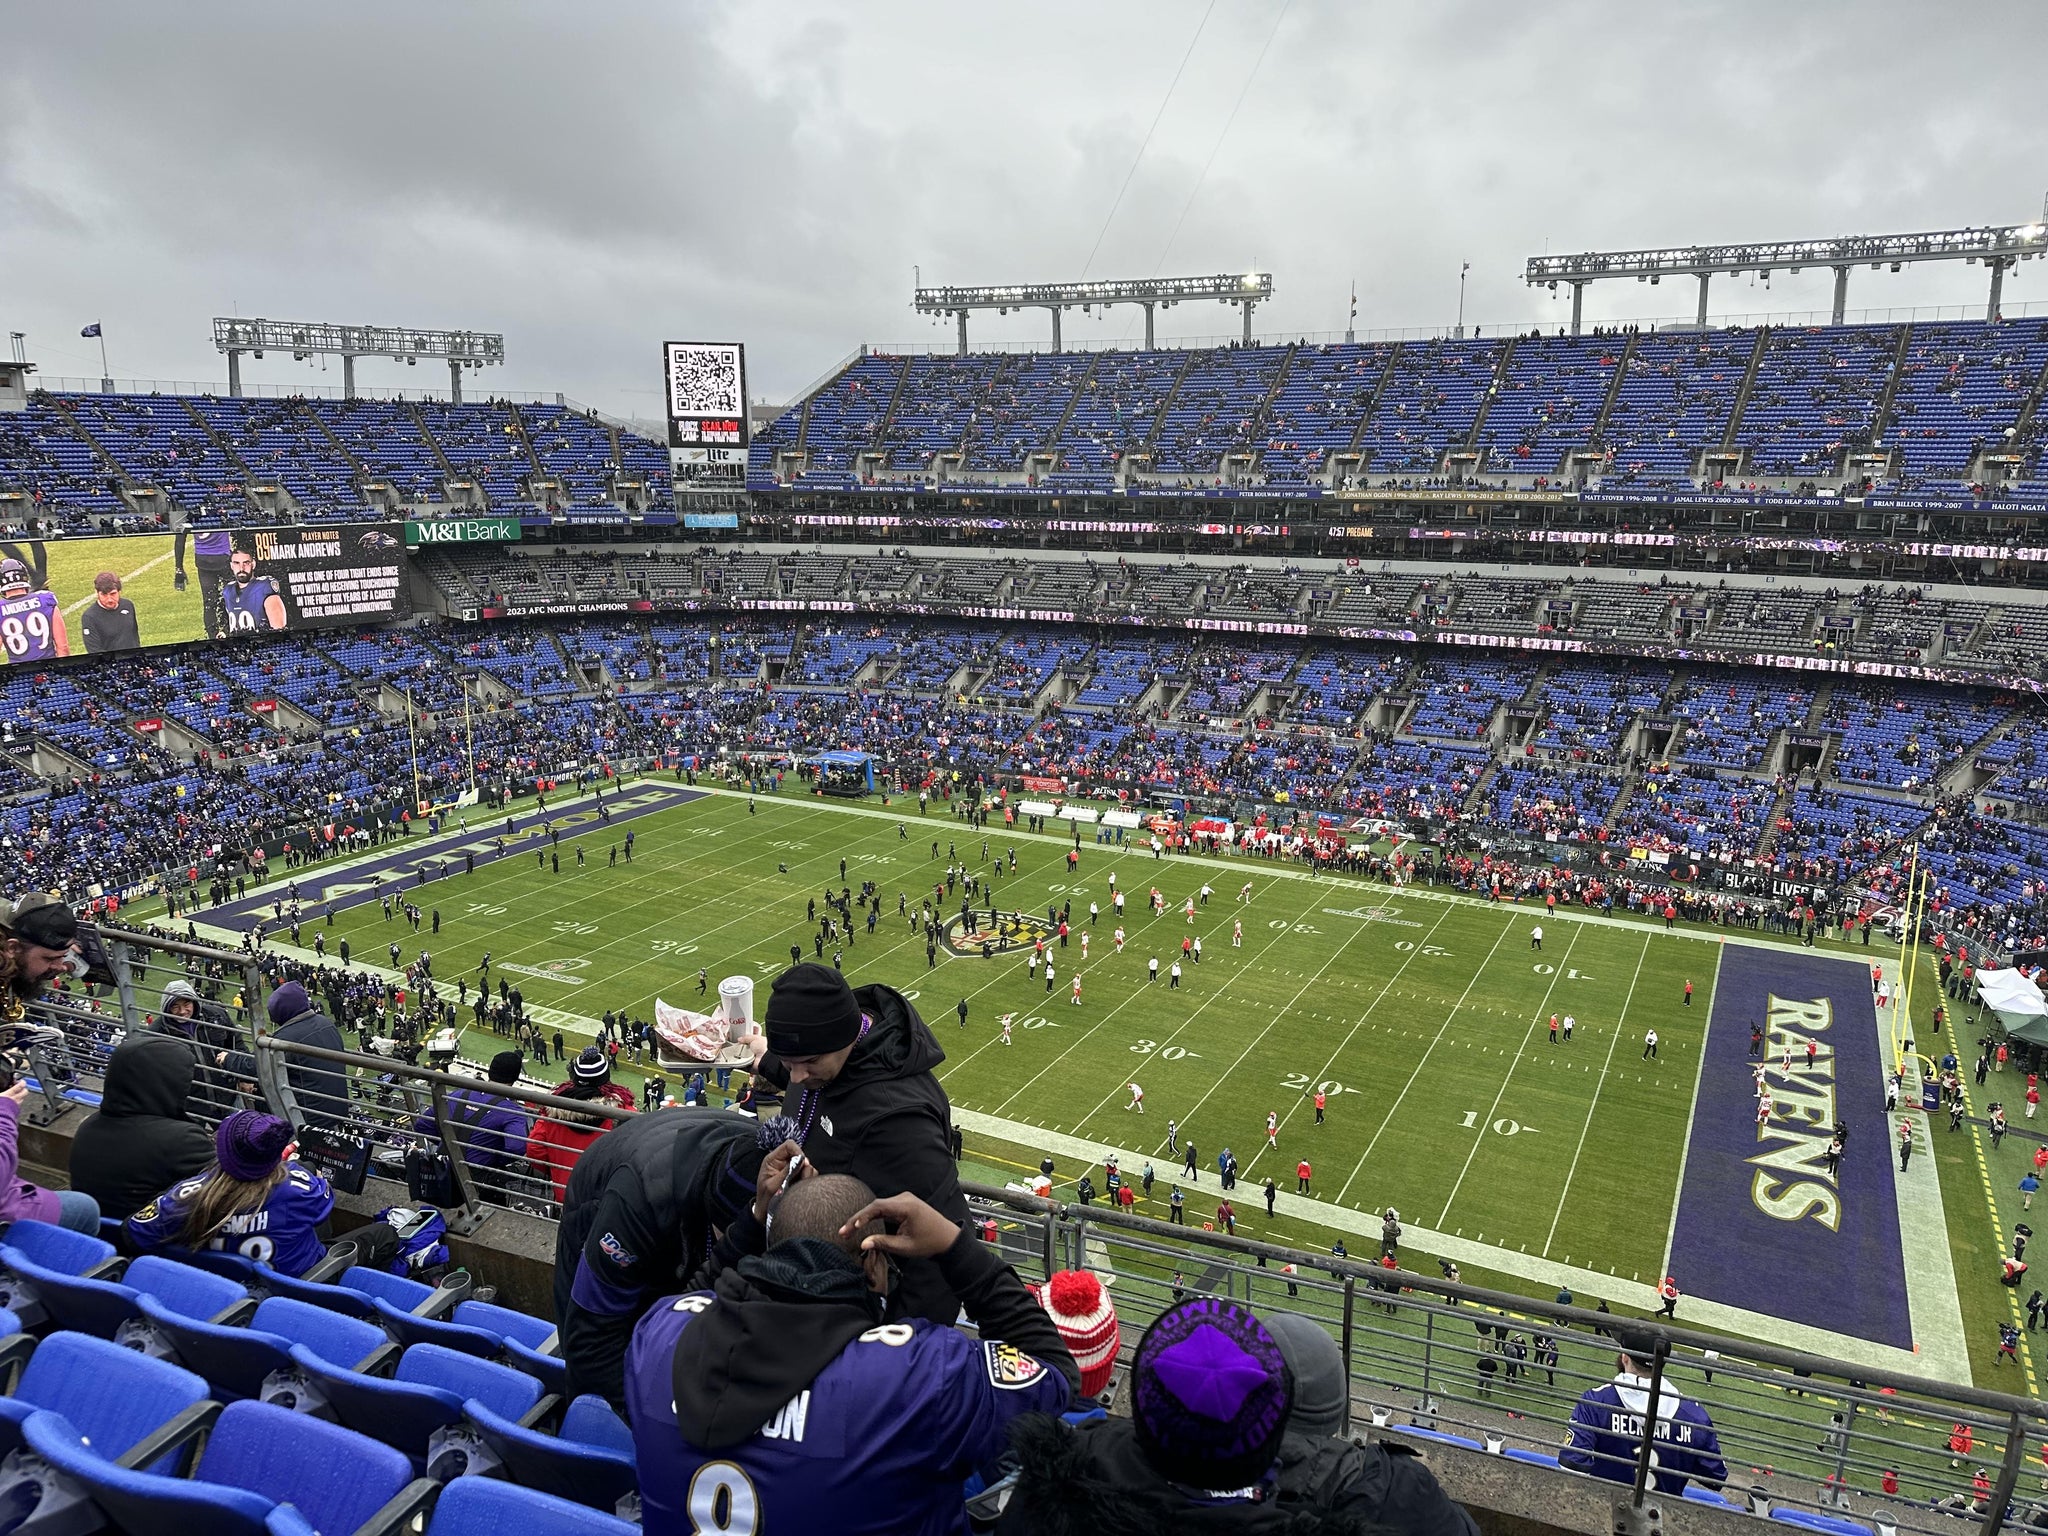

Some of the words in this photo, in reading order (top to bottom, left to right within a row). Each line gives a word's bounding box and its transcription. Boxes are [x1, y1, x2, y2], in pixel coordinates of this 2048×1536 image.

[722, 421, 738, 431] NOW
[706, 449, 729, 462] Lite
[302, 532, 322, 541] PLAYER
[322, 531, 340, 540] NOTES
[416, 522, 465, 542] M&T
[466, 520, 511, 540] Bank
[1346, 527, 1374, 538] PREGAME
[254, 532, 270, 560] 89
[268, 532, 278, 544] TE
[270, 544, 296, 560] MARK
[298, 542, 341, 558] ANDREWS
[288, 572, 306, 583] MARK
[307, 572, 314, 582] IS
[314, 571, 326, 582] ONE
[326, 570, 334, 580] OF
[334, 570, 350, 580] FOUR
[350, 568, 366, 578] TIGHT
[367, 567, 382, 578] ENDS
[382, 566, 399, 576] SINCE
[291, 584, 304, 595] 1970
[305, 582, 322, 594] WITH
[322, 582, 330, 592] 40
[330, 580, 360, 592] RECEIVING
[360, 577, 399, 590] TOUCHDOWNS
[297, 596, 304, 606] IN
[304, 595, 316, 606] THE
[316, 594, 332, 605] FIRST
[332, 592, 342, 604] SIX
[343, 591, 361, 603] YEARS
[362, 590, 369, 601] OF
[369, 590, 374, 600] A
[374, 588, 396, 600] CAREER
[2, 598, 41, 616] ANDREWS
[324, 604, 352, 616] GRAHAM,
[506, 608, 526, 616] 2023
[529, 606, 545, 614] AFC
[547, 604, 576, 613] NORTH
[578, 603, 628, 612] CHAMPIONS
[2, 611, 50, 655] 89
[9, 744, 32, 755] GEHA
[122, 880, 154, 900] RAVENS
[552, 922, 598, 934] 20
[1268, 919, 1314, 934] 30
[651, 940, 699, 956] 30
[1394, 940, 1440, 956] 20
[1533, 963, 1583, 980] 10
[1129, 1040, 1186, 1060] 30
[1280, 1072, 1343, 1096] 20
[1742, 992, 1842, 1233] RAVENS
[1457, 1110, 1520, 1136] 10
[222, 1211, 268, 1234] SMITH
[858, 1323, 914, 1346] 8
[1676, 1425, 1692, 1443] JR
